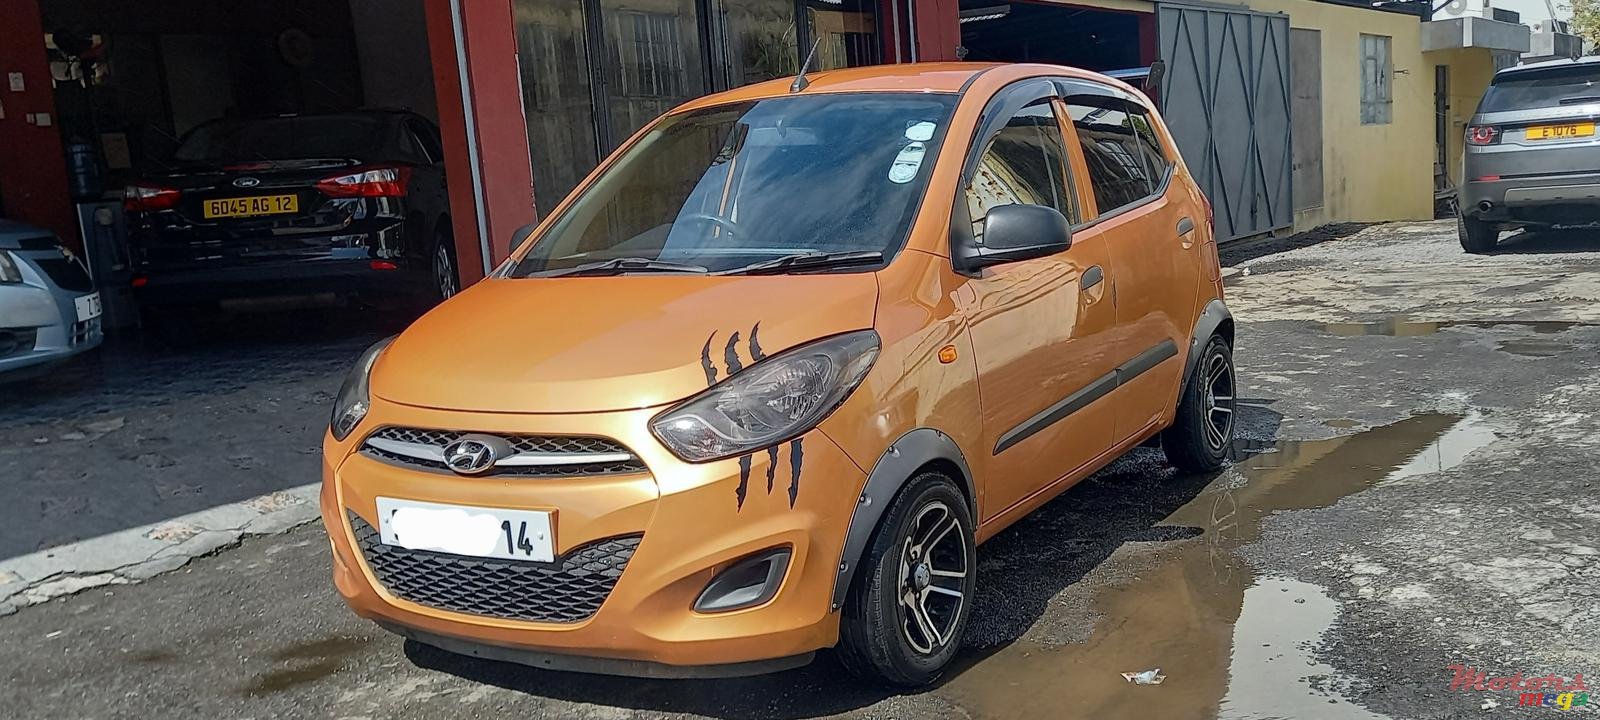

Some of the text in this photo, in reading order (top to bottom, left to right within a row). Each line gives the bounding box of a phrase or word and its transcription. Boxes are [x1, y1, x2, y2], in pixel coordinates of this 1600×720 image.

[1542, 125, 1577, 137] E 1076
[211, 196, 292, 216] 6045 AG 12
[501, 520, 533, 556] 14
